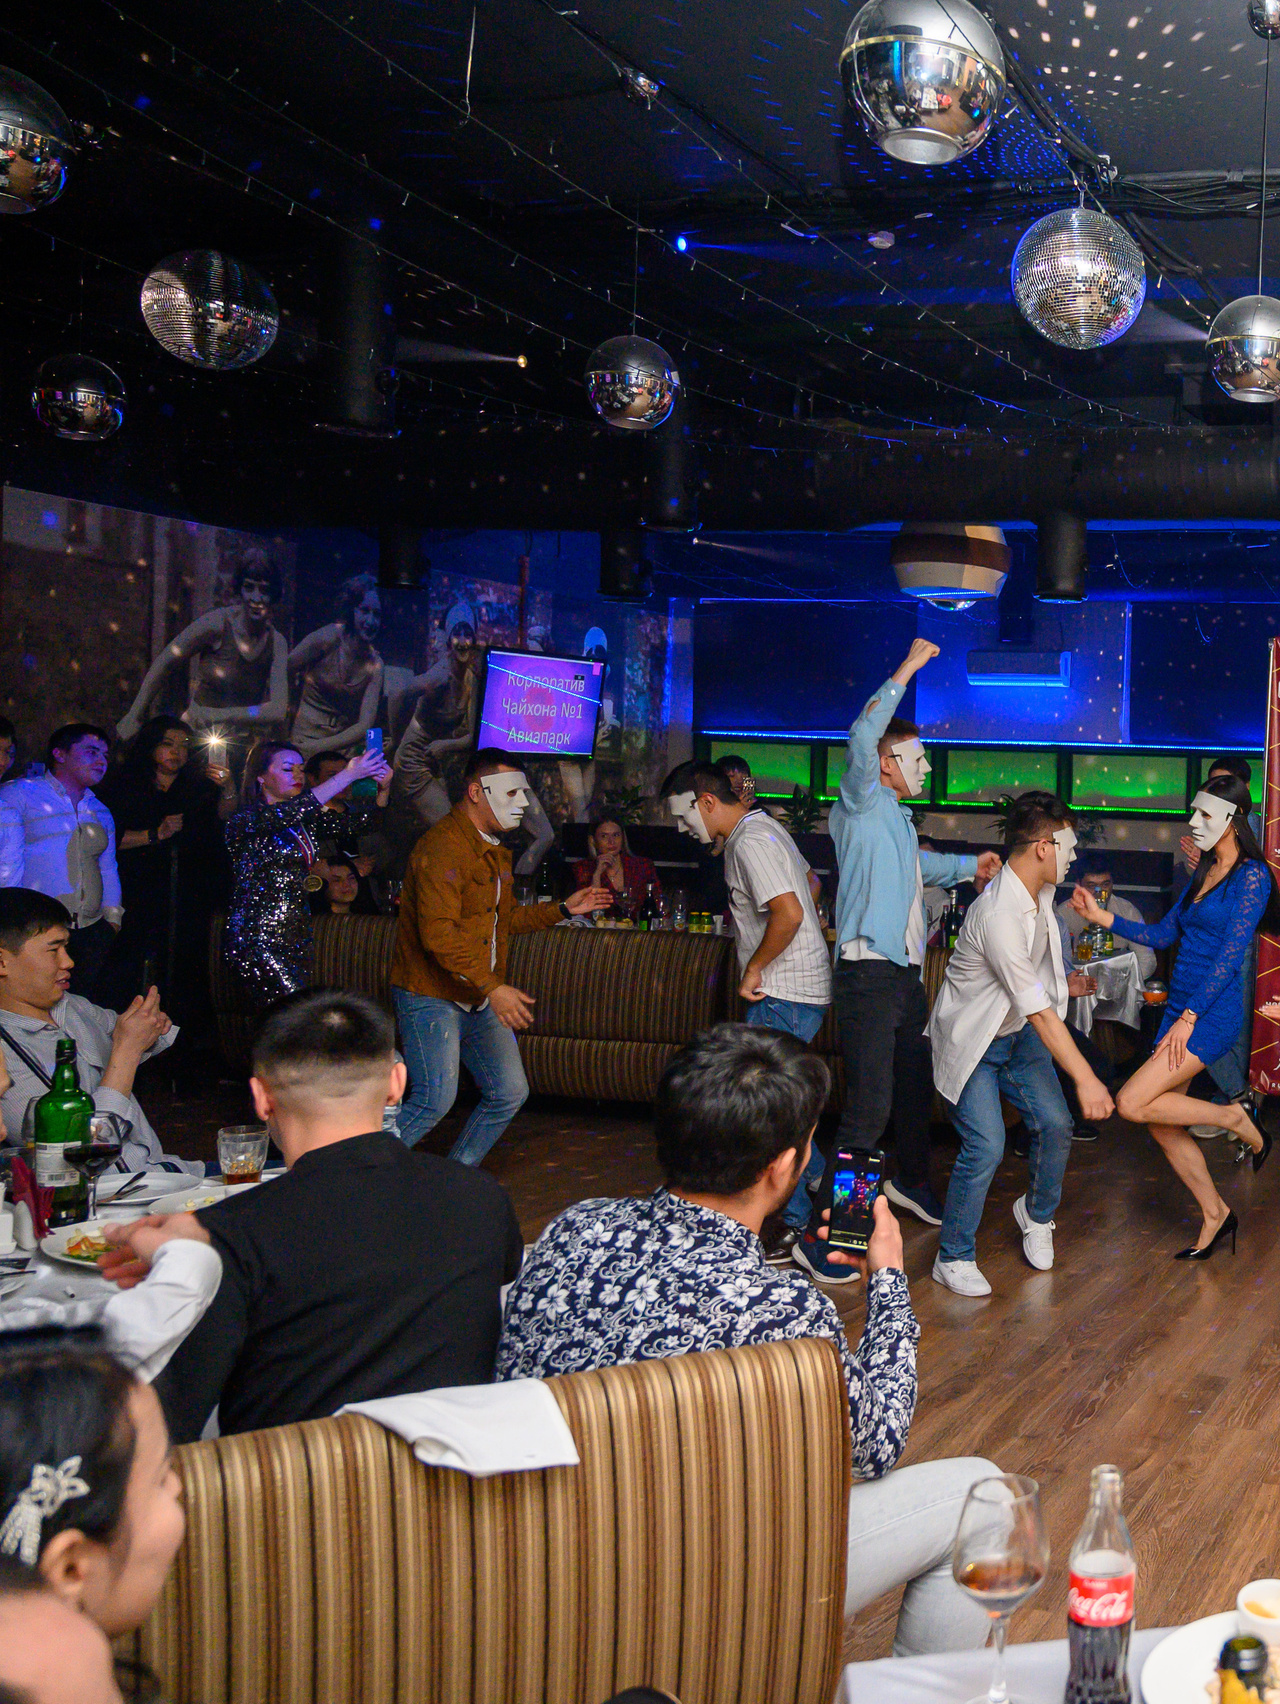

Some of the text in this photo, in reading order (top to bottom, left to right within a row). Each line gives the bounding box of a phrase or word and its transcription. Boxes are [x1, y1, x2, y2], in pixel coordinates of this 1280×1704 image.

[507, 673, 585, 693] Корпоратив
[502, 698, 583, 719] Чайхона №1
[507, 727, 571, 747] Авиапарк
